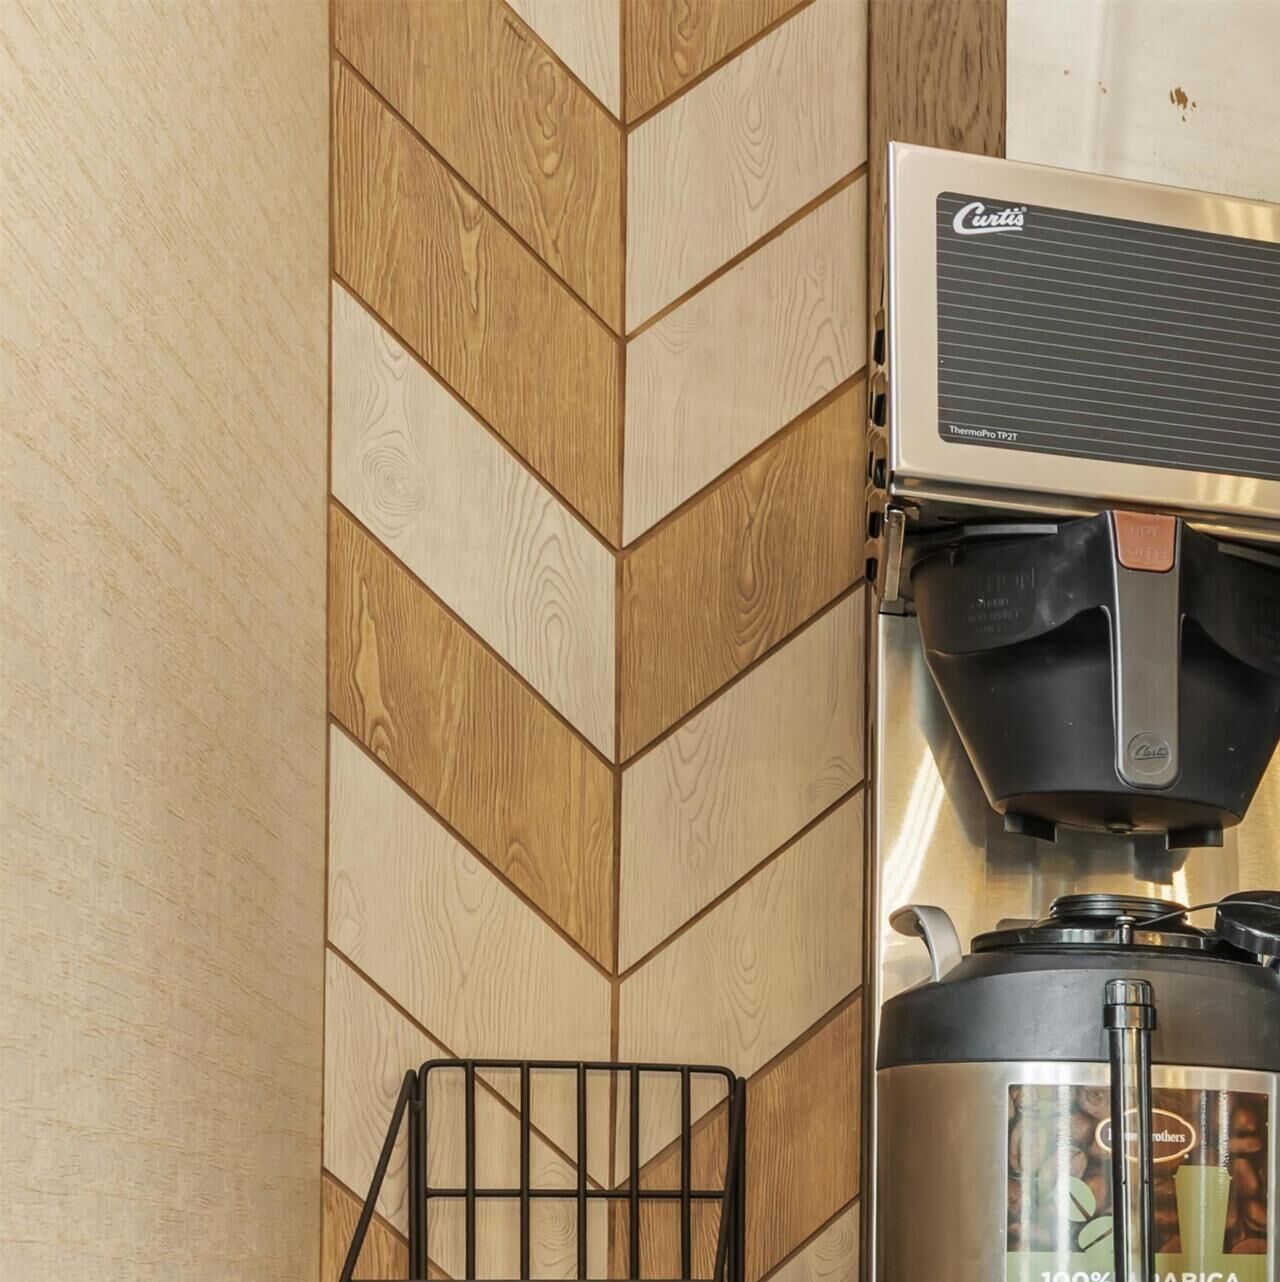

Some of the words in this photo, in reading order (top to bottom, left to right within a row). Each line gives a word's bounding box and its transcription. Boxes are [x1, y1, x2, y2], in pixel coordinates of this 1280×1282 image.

[953, 202, 1025, 235] Curtis
[949, 425, 996, 439] ThermoPro
[997, 431, 1018, 441] TP2T
[1152, 1129, 1186, 1143] rothers
